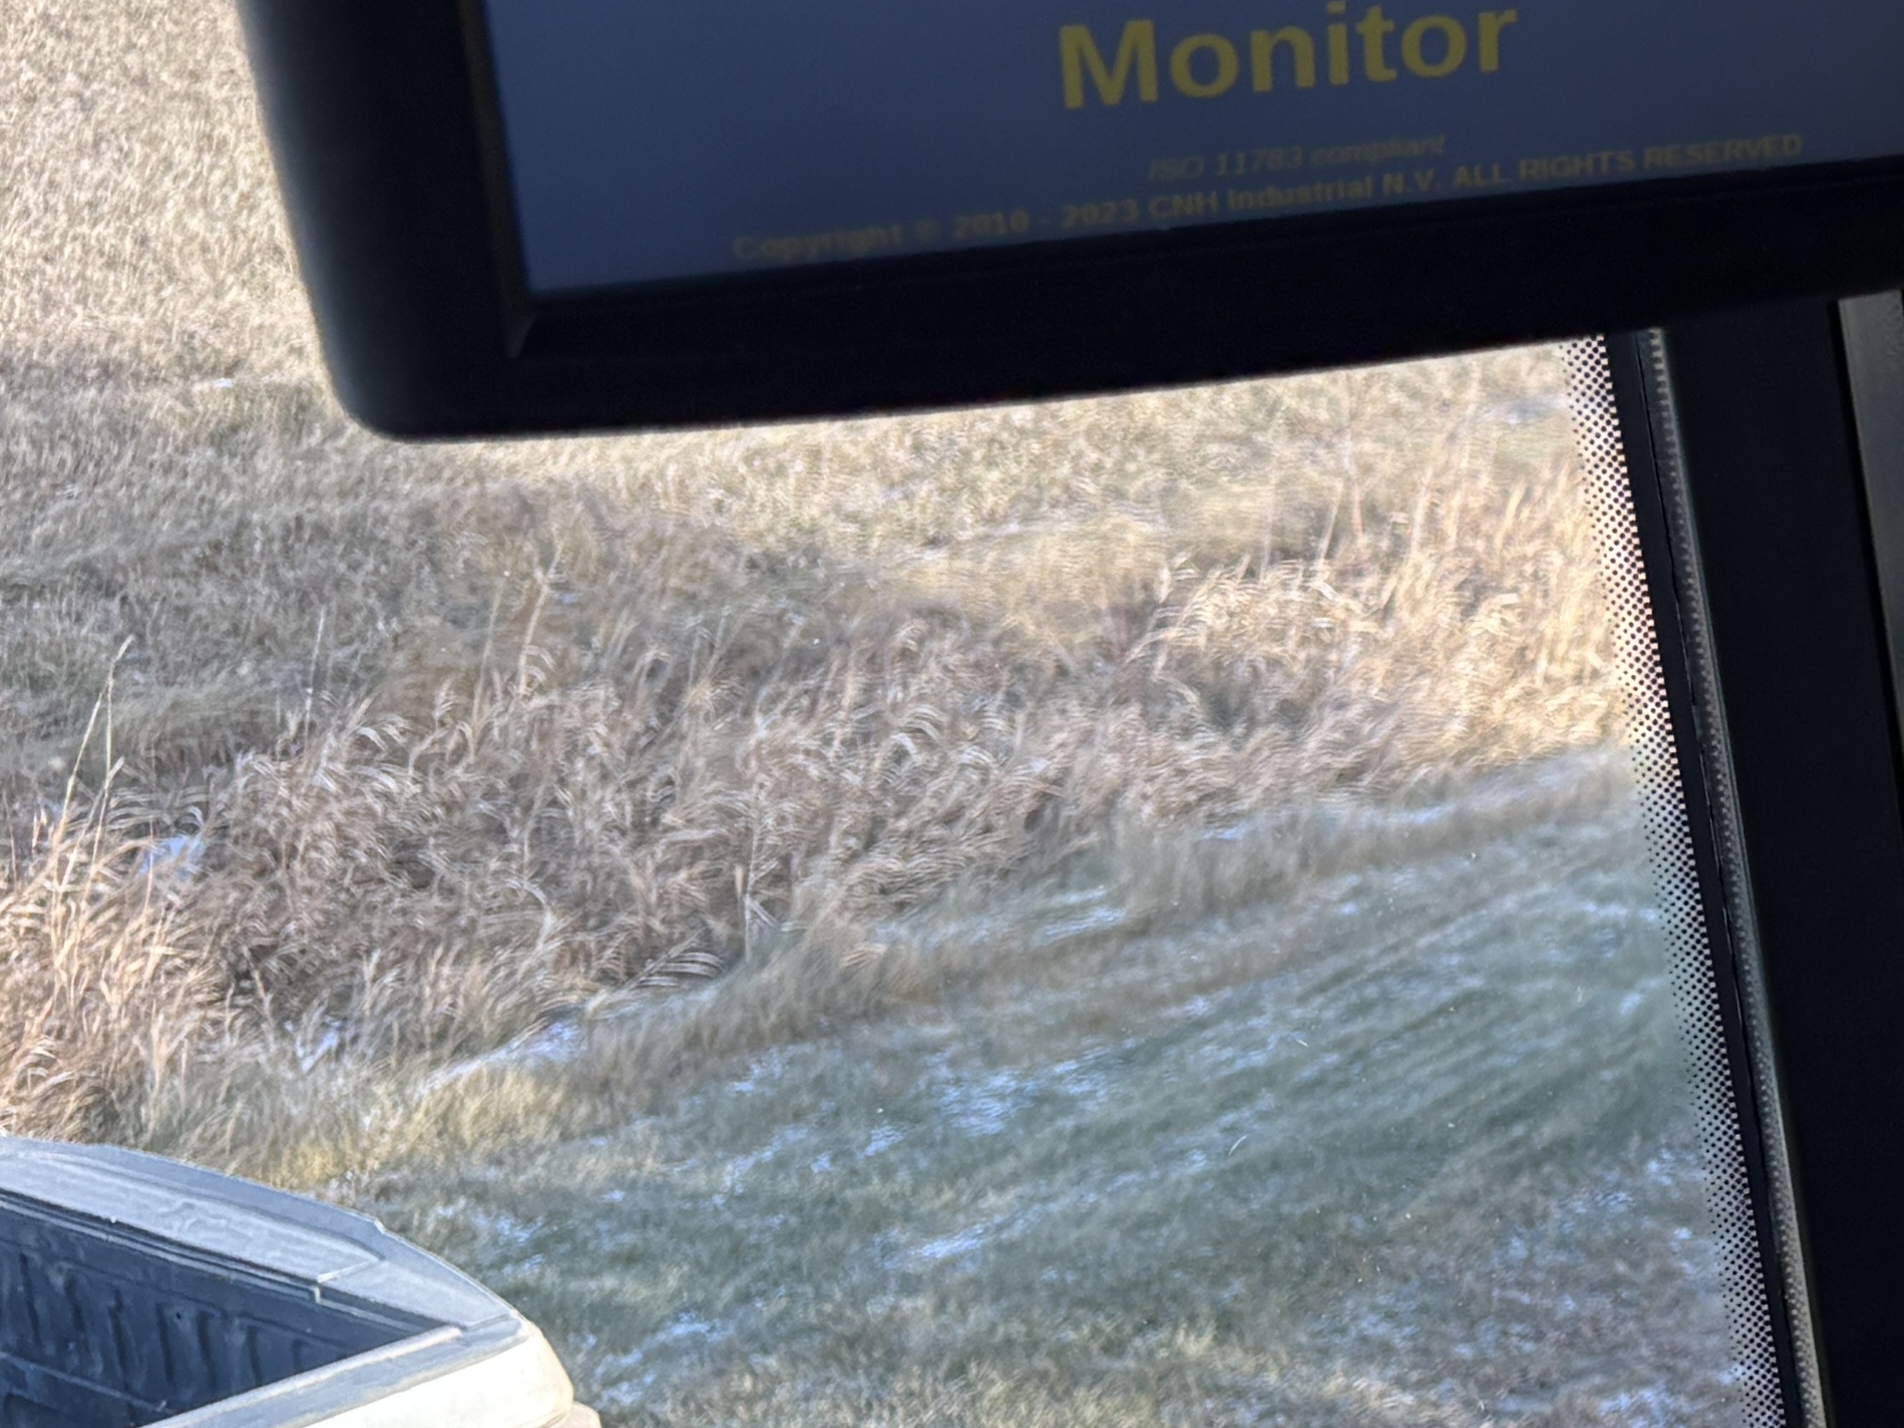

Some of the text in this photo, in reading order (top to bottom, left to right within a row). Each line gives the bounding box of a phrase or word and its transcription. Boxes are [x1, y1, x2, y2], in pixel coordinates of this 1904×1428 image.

[732, 223, 899, 263] Copyright
[1062, 197, 1139, 229] 2023
[1149, 188, 1217, 220] CNH
[1228, 174, 1373, 211] Industrial
[1454, 165, 1508, 189] ALL
[1520, 148, 1634, 181] RIGHTS
[1644, 132, 1804, 169] RESERVED
[1148, 133, 1445, 182] ISO 11783 compliant
